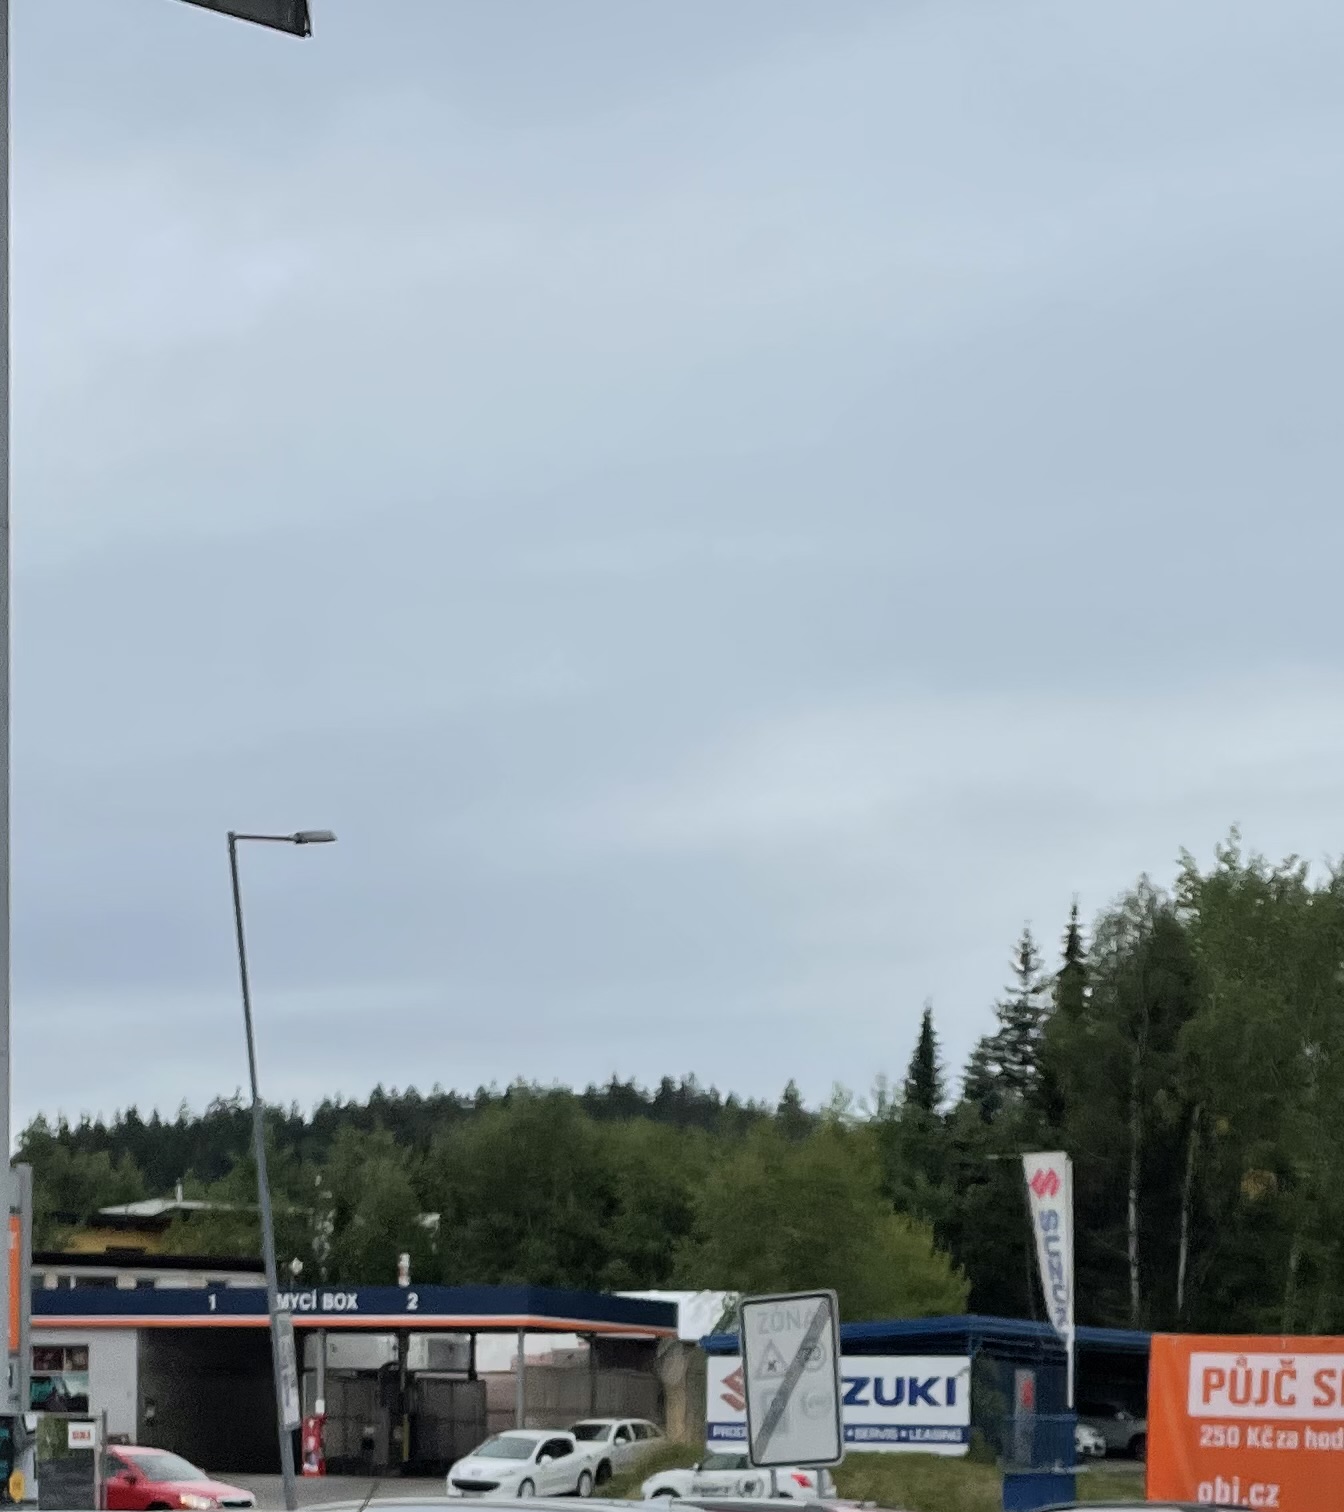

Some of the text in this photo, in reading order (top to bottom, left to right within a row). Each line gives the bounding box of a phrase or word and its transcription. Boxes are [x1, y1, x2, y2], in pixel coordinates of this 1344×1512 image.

[1039, 1208, 1068, 1328] SUZUK
[208, 1293, 217, 1311] 1
[322, 1292, 359, 1310] BOX
[406, 1292, 419, 1310] 2
[841, 1376, 957, 1407] ZUKI
[1202, 1355, 1297, 1407] PŮJČ
[1199, 1425, 1240, 1449] 250
[1247, 1424, 1273, 1449] Kč
[1276, 1430, 1299, 1450] za
[1197, 1475, 1281, 1509] obi.cz
